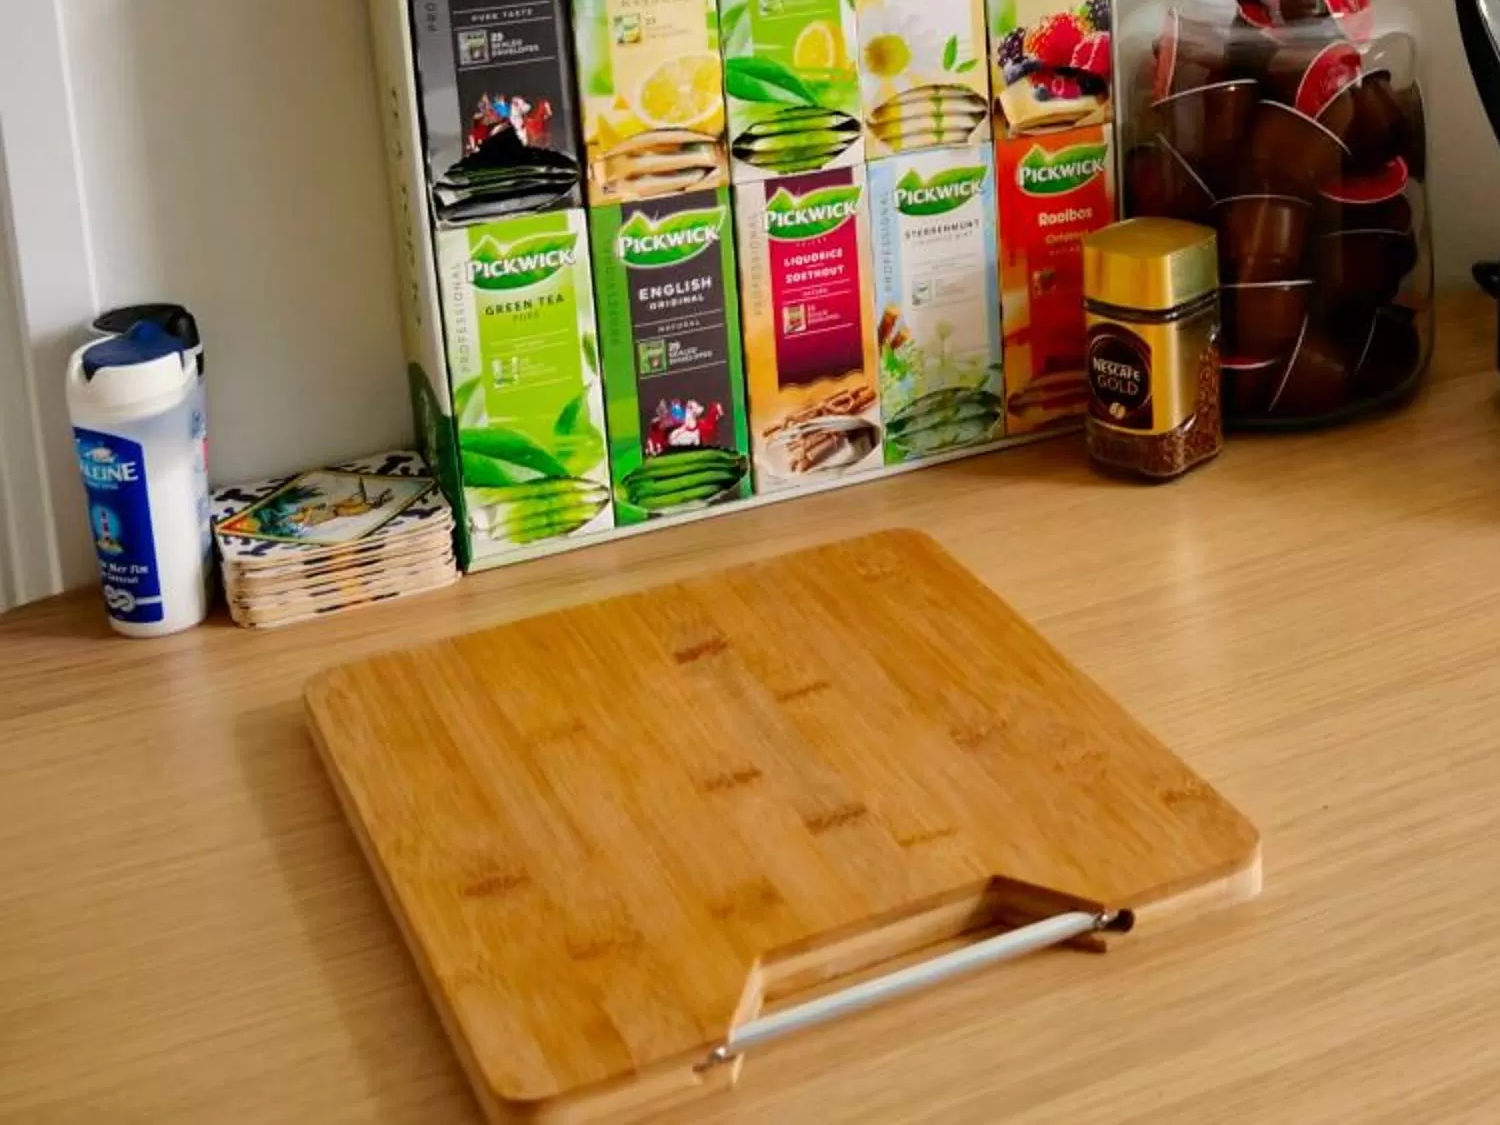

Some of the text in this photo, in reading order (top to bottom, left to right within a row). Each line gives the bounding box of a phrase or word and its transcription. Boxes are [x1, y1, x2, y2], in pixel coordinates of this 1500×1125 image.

[1018, 158, 1105, 187] PICKWICK
[894, 179, 983, 208] PICKWICK
[762, 201, 857, 231] PICKWICK
[1038, 207, 1093, 227] Rooibos
[617, 227, 720, 258] PICKWICK
[466, 250, 576, 283] PICKWICK
[784, 247, 843, 267] LIQUORICE
[638, 276, 713, 302] ENGLISH
[485, 294, 565, 316] GREEN TEA
[649, 295, 705, 311] ORIGINAL
[1097, 375, 1139, 395] GOLD
